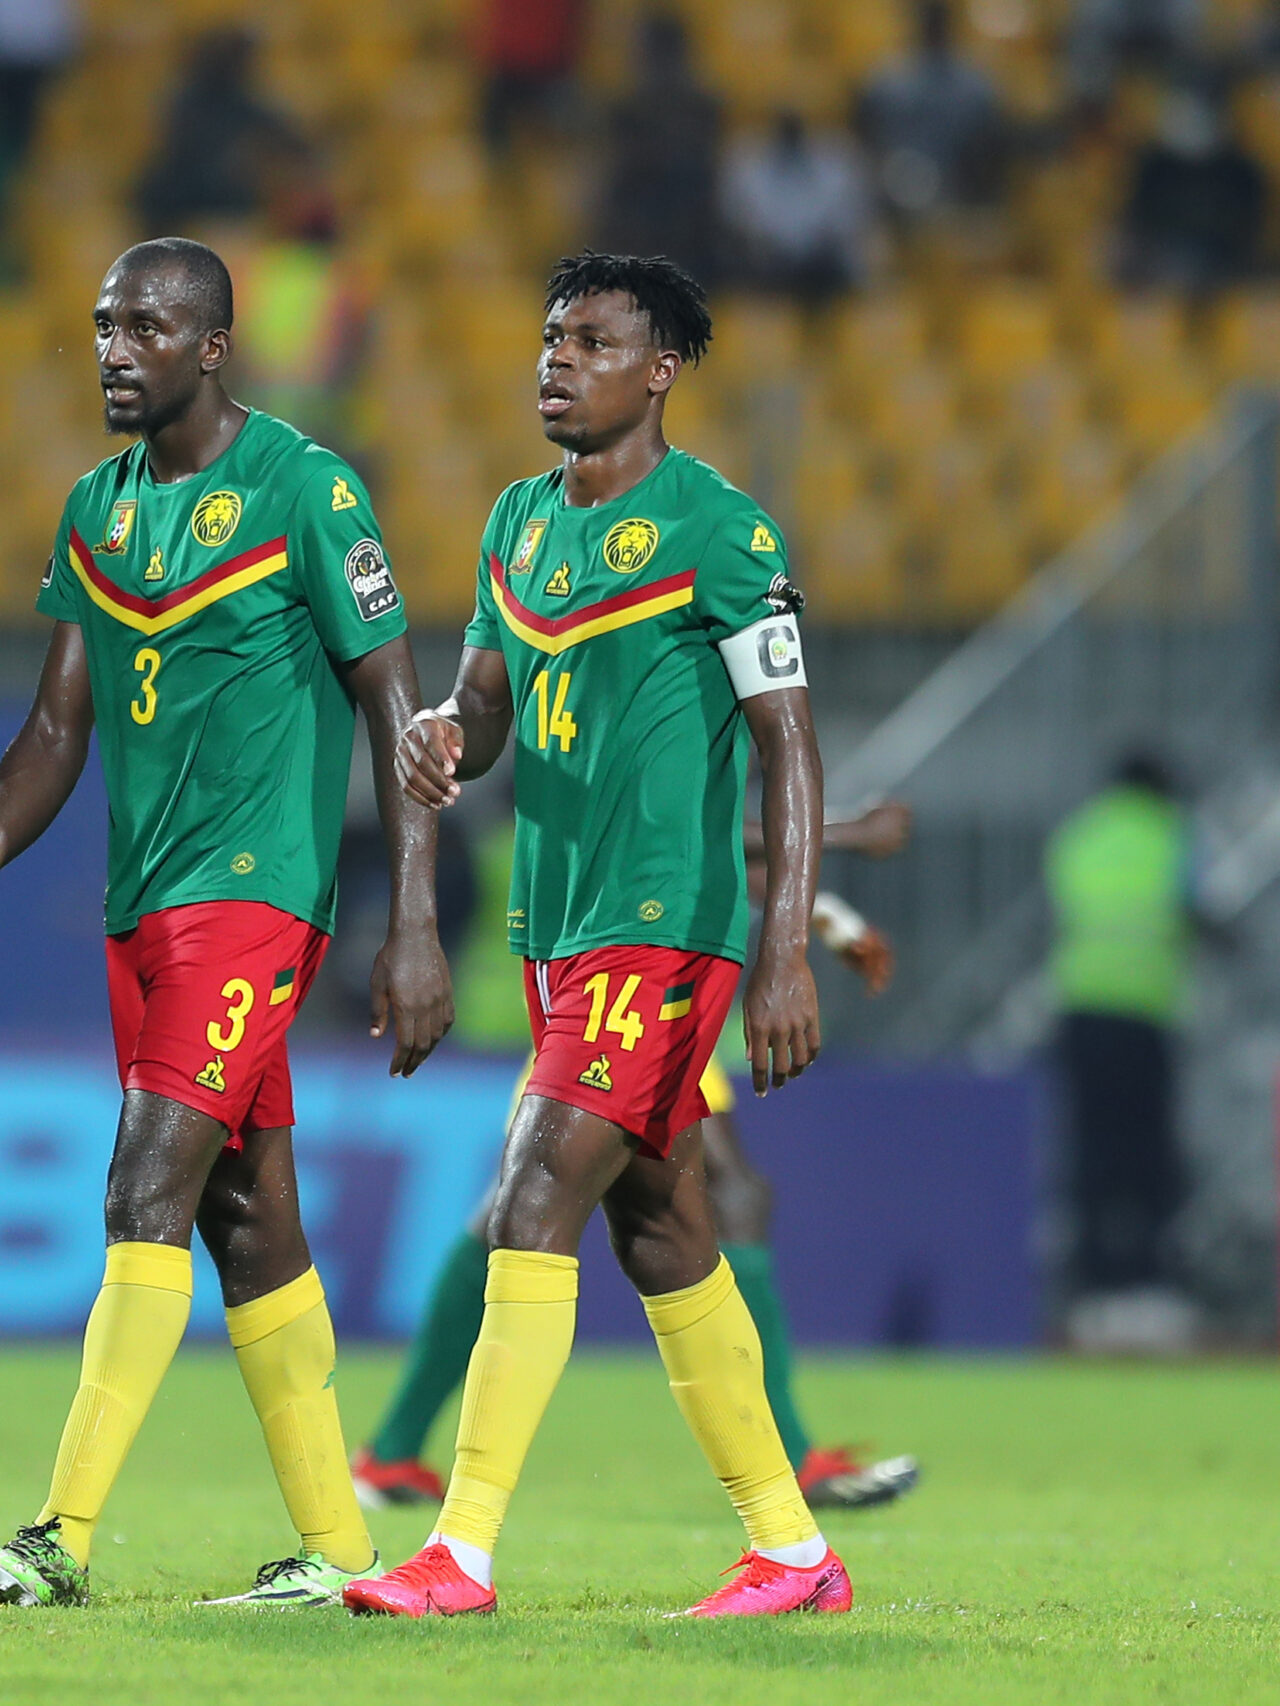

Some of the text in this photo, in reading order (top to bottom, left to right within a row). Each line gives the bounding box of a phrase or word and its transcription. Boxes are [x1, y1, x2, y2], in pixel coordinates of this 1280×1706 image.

[368, 594, 395, 612] CAF
[130, 647, 161, 725] 3
[756, 625, 798, 678] C
[533, 670, 576, 753] 14
[207, 977, 255, 1052] 3
[582, 972, 644, 1051] 14
